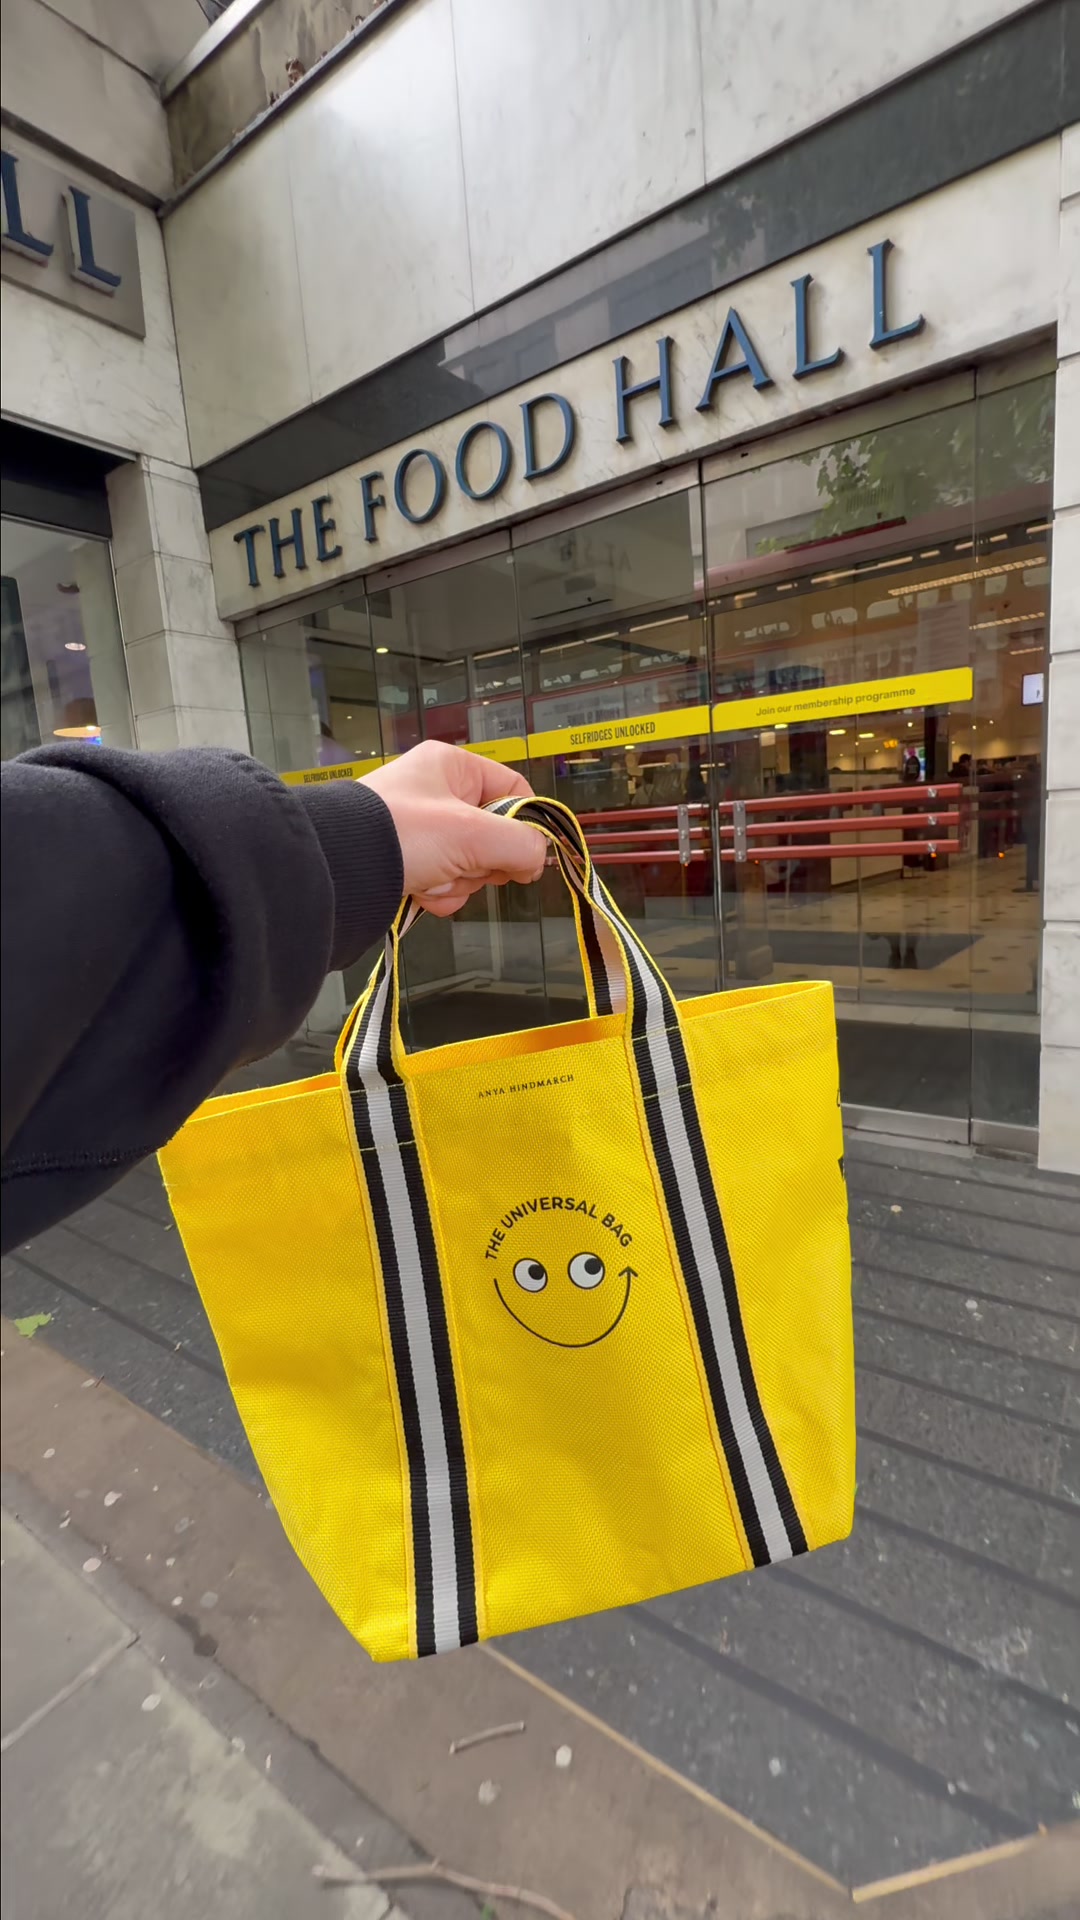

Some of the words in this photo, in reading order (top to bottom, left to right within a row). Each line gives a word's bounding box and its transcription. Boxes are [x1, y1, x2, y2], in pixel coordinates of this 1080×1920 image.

[233, 495, 342, 588] THE
[359, 392, 576, 544] FOOD
[612, 238, 926, 444] HALL
[756, 707, 775, 717] Join
[777, 705, 792, 714] our
[794, 696, 854, 711] membership
[855, 688, 916, 704] programme
[570, 728, 613, 746] SELFRIDGES
[615, 721, 656, 738] UNLOCKED
[329, 767, 354, 781] UNLOCKED
[478, 1087, 505, 1099] ANYA
[509, 1074, 575, 1093] HINDMARCH
[485, 1227, 506, 1261] THE
[501, 1196, 598, 1230] UNIVERSAL
[601, 1212, 633, 1249] BAG
